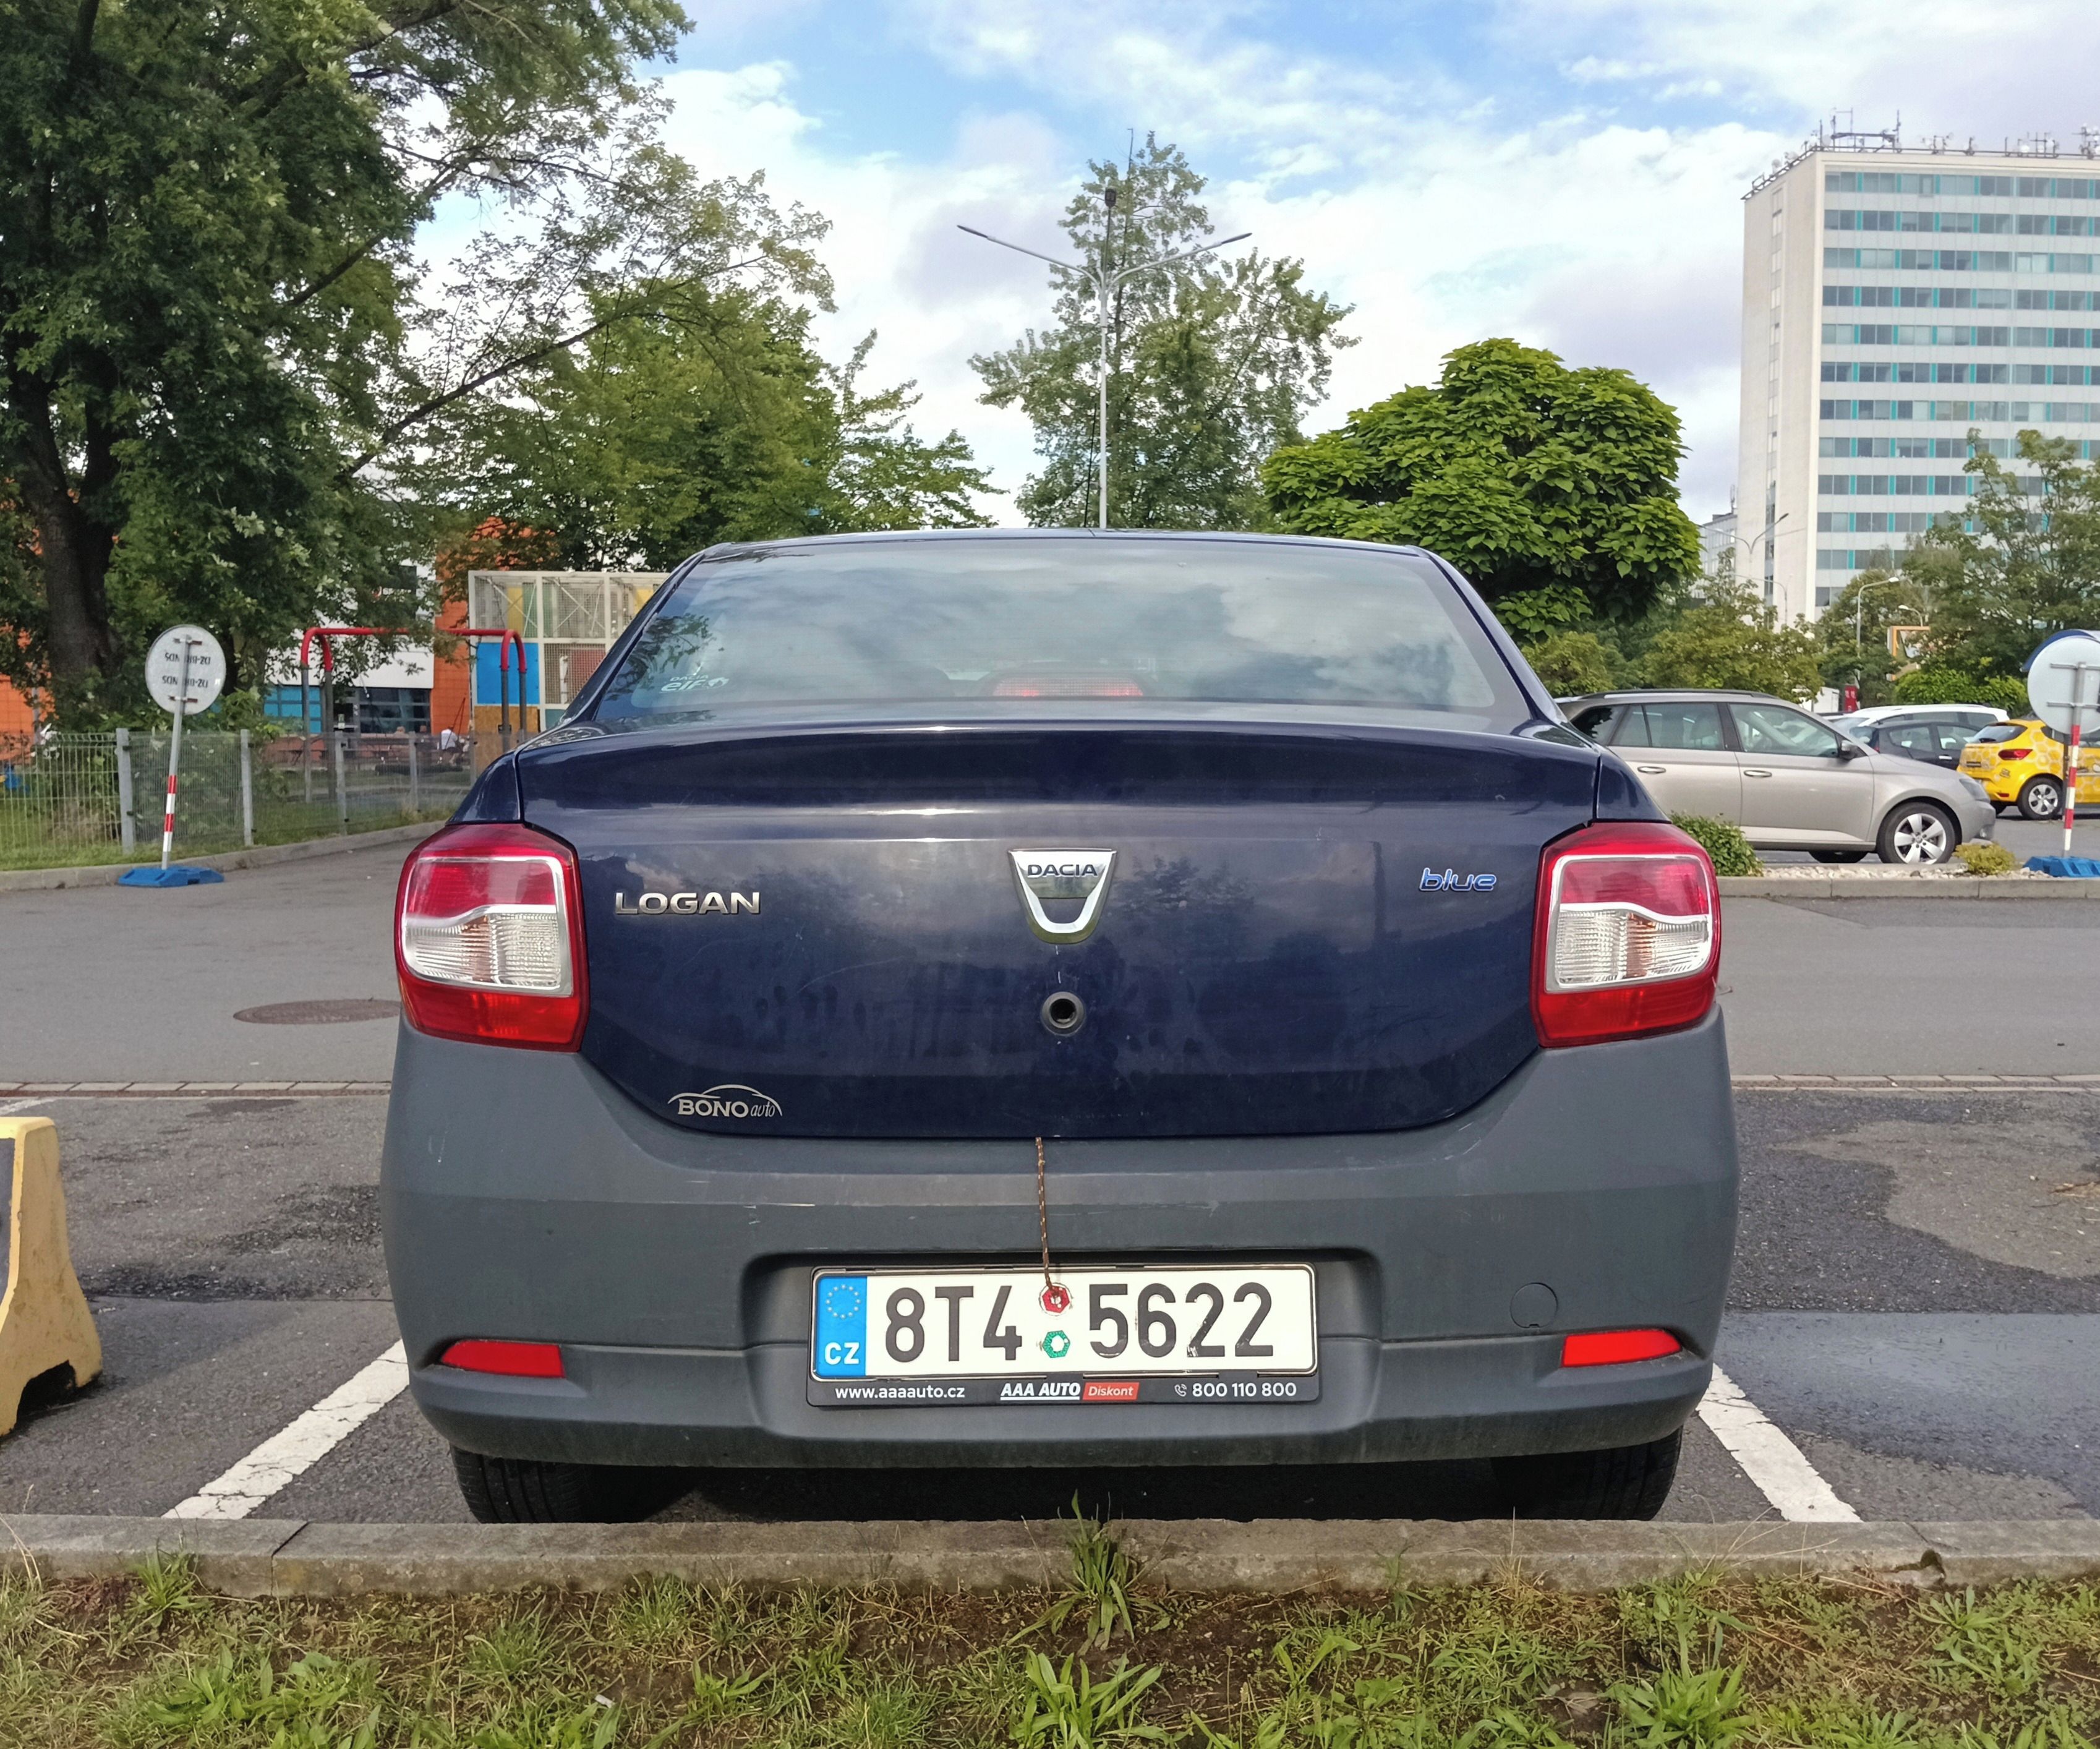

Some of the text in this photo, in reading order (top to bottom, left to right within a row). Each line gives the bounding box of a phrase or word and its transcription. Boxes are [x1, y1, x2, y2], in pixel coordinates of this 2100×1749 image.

[1027, 864, 1098, 876] DACIA
[1419, 867, 1497, 891] blue
[615, 892, 760, 914] LOGAN
[678, 1099, 775, 1118] BONO auto
[886, 1282, 1273, 1362] 8T4 5622
[824, 1341, 860, 1365] CZ
[835, 1385, 965, 1398] www.aaaauto.cz
[1001, 1382, 1081, 1396] AAA AUTO
[1088, 1385, 1133, 1396] Diskont
[1192, 1382, 1297, 1396] 800 110 800
